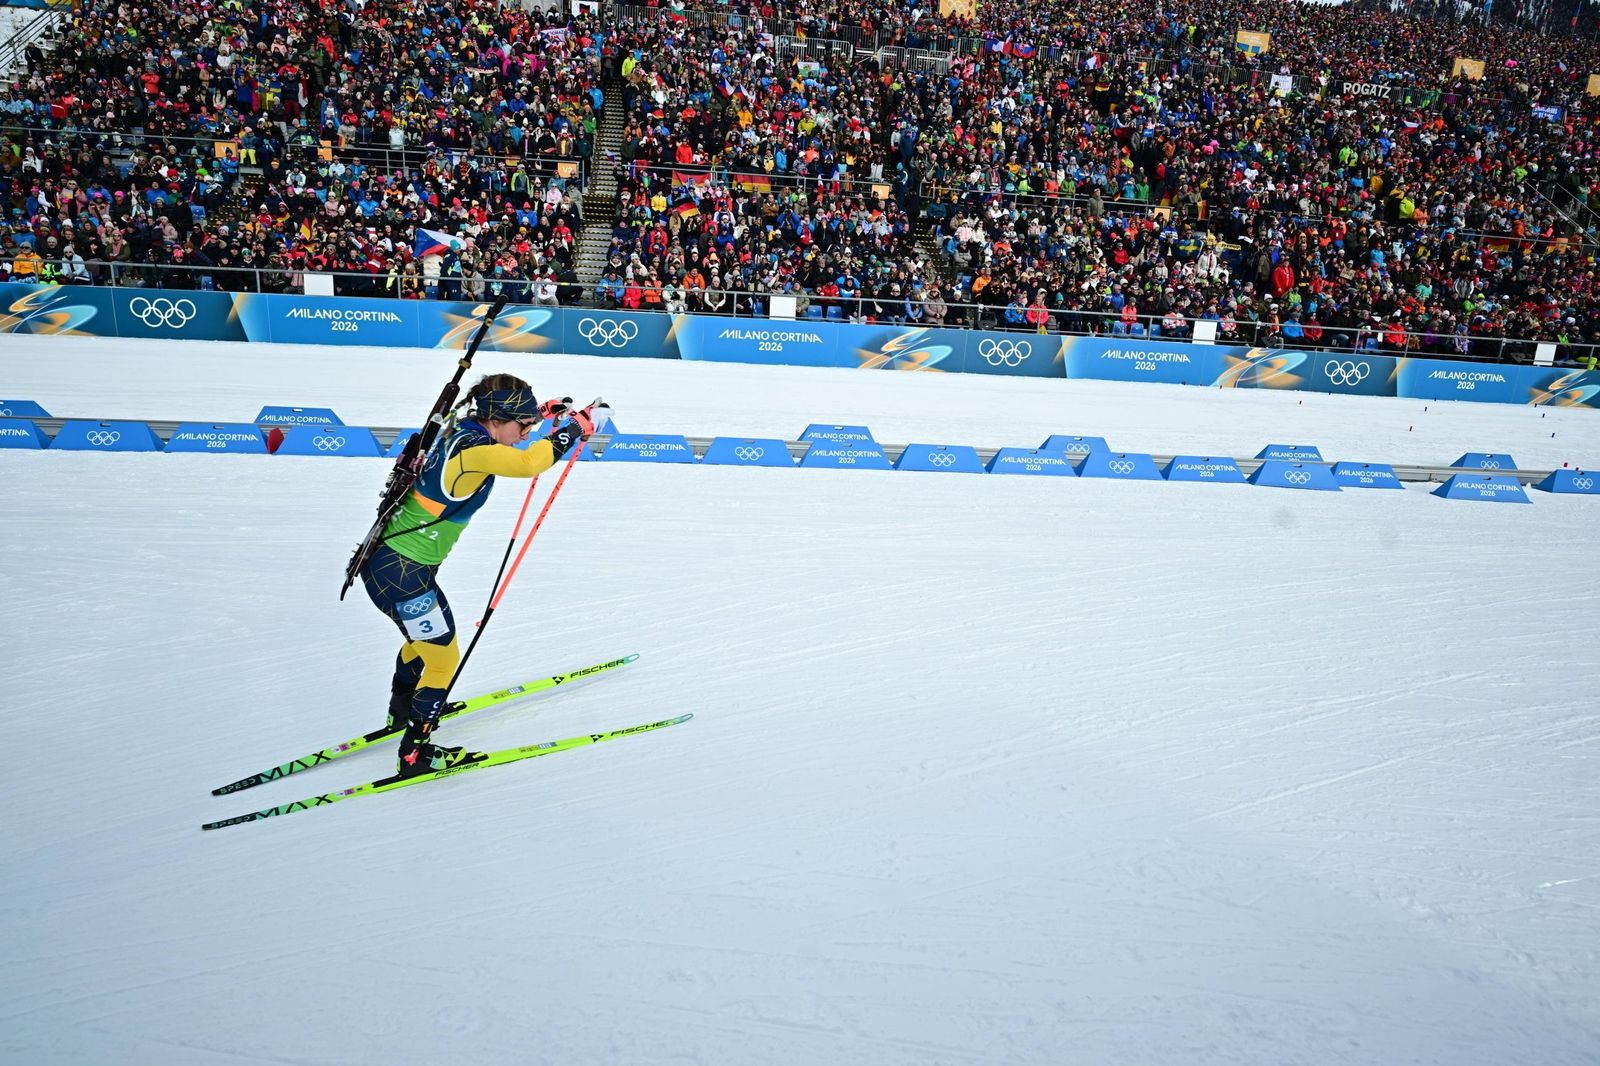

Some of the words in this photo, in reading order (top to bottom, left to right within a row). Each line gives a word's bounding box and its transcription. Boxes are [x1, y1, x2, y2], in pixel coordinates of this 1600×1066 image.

[286, 308, 342, 320] MILANO
[344, 310, 402, 323] CORTINA
[331, 321, 358, 332] 2026
[718, 329, 770, 341] MILANO
[771, 331, 823, 343] CORTINA
[758, 341, 783, 352] 2026
[1101, 349, 1147, 361] MILANO
[1147, 352, 1191, 364] CORTINA
[1135, 360, 1156, 371] 2026
[1428, 370, 1467, 381] MILANO
[1467, 373, 1506, 383] CORTINA
[1457, 380, 1475, 390] 2026
[260, 414, 296, 422] MILANO
[296, 416, 332, 424] CORTINA
[0, 428, 30, 437] RTINA
[175, 433, 217, 441] MILANO
[217, 434, 259, 442] CORTINA
[807, 431, 838, 440] MILANO
[838, 433, 870, 441] CORTINA
[207, 440, 227, 448] 2026
[610, 442, 648, 451] MILANO
[648, 444, 686, 452] CORTINA
[639, 449, 658, 457] 2026
[811, 449, 846, 457] MILANO
[846, 450, 882, 459] CORTINA
[1268, 451, 1294, 459] MILANO
[1294, 452, 1320, 460] CORTINA
[838, 456, 856, 464] 2026
[1000, 456, 1033, 464] MILANO
[1033, 458, 1066, 466] CORTINA
[1025, 463, 1042, 471] 2026
[1176, 463, 1206, 472] MILANO
[1206, 464, 1237, 473] CORTINA
[1199, 470, 1215, 478] 2026
[1338, 468, 1366, 477] MILANO
[1366, 470, 1395, 479] CORTINA
[1360, 476, 1374, 484] 2026
[1455, 482, 1487, 491] MILANO
[1487, 483, 1520, 492] CORTINA
[1480, 489, 1496, 498] 2026
[419, 620, 434, 633] 3
[570, 659, 625, 679] FISCHER
[219, 778, 257, 795] SPEED
[260, 750, 332, 781] MAX
[435, 762, 480, 778] FISCHER
[211, 815, 251, 829] SPEED
[256, 793, 334, 819] MAX
